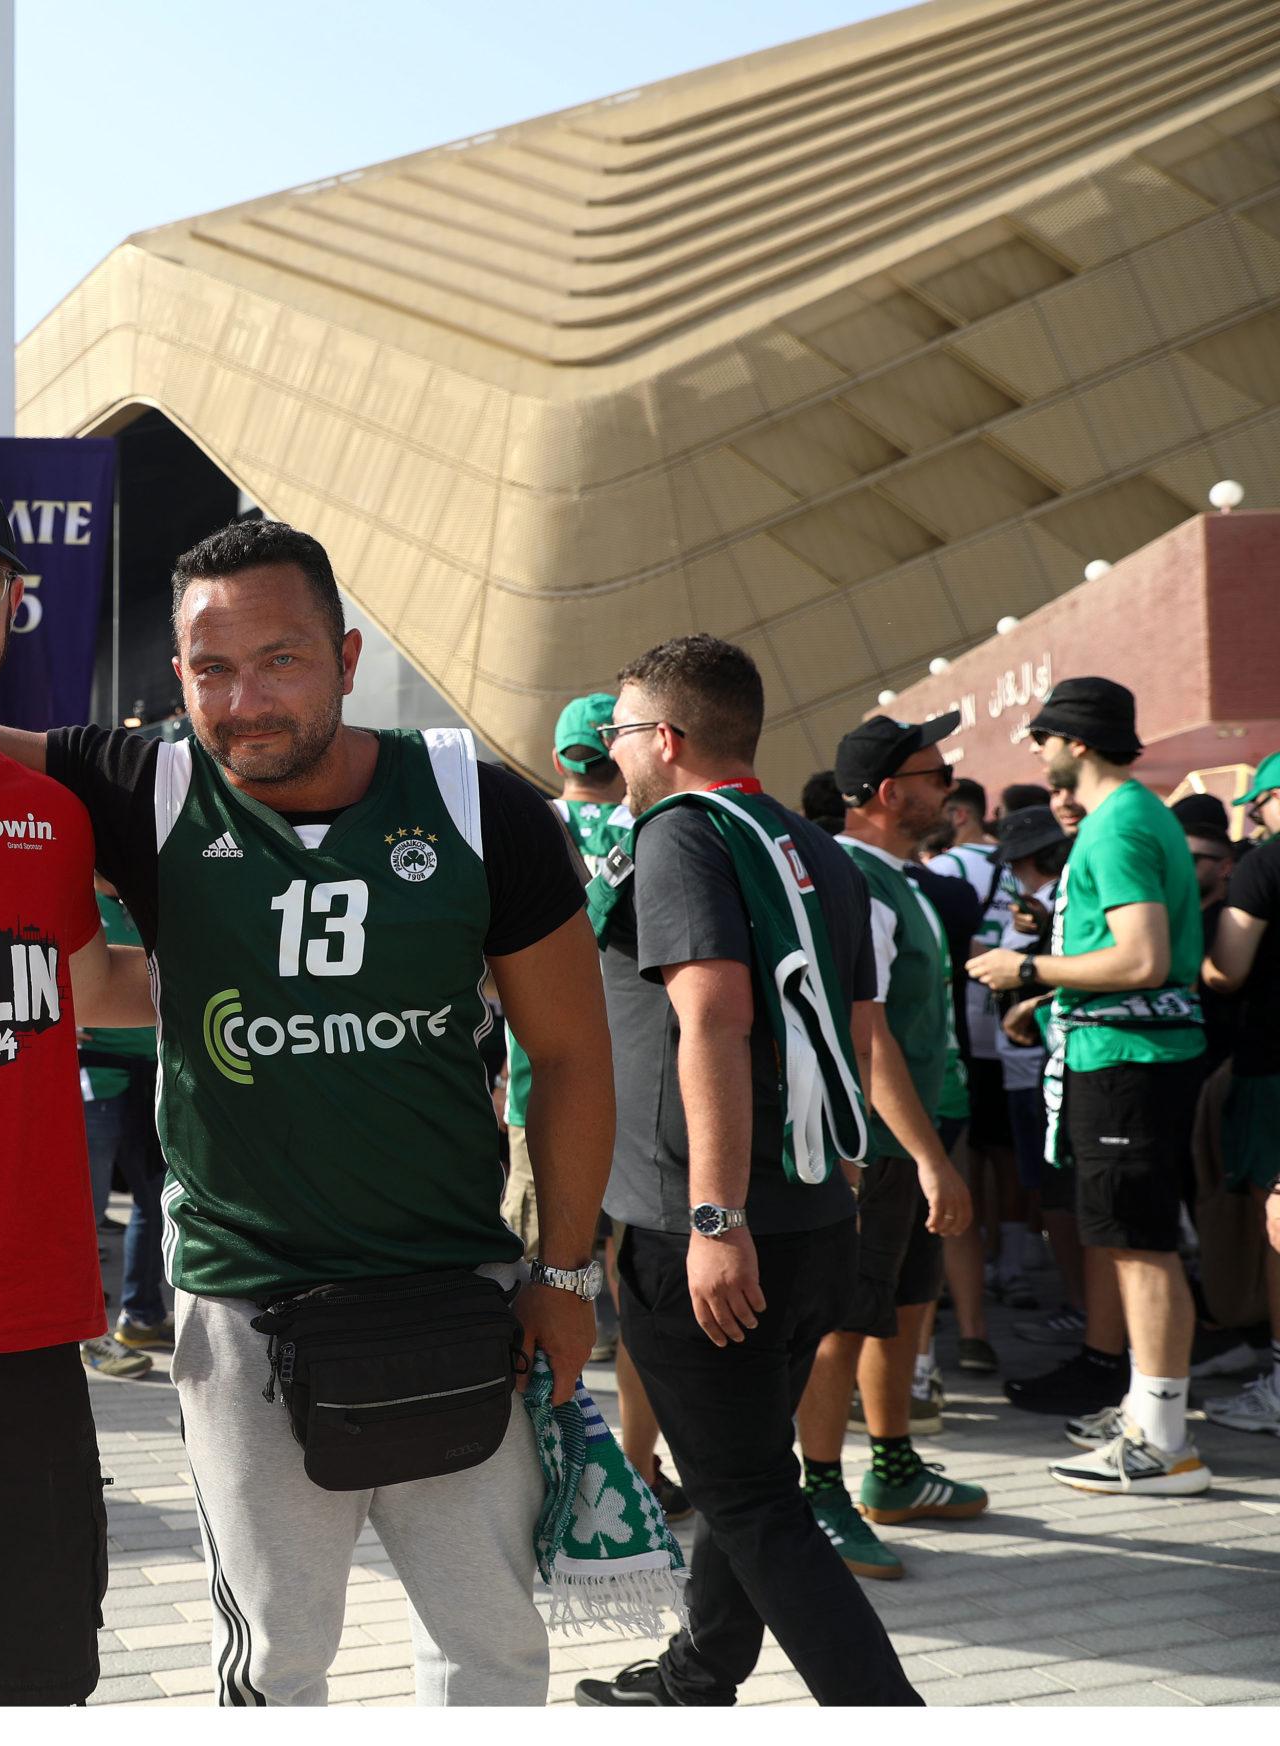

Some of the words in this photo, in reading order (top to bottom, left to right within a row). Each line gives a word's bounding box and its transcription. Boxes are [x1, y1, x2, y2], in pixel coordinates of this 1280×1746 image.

[10, 499, 93, 546] ATE
[7, 841, 23, 850] Grand
[202, 848, 244, 858] adidas
[391, 840, 427, 872] PANATHINAIKOS
[407, 872, 426, 881] 1908
[270, 879, 369, 977] 13
